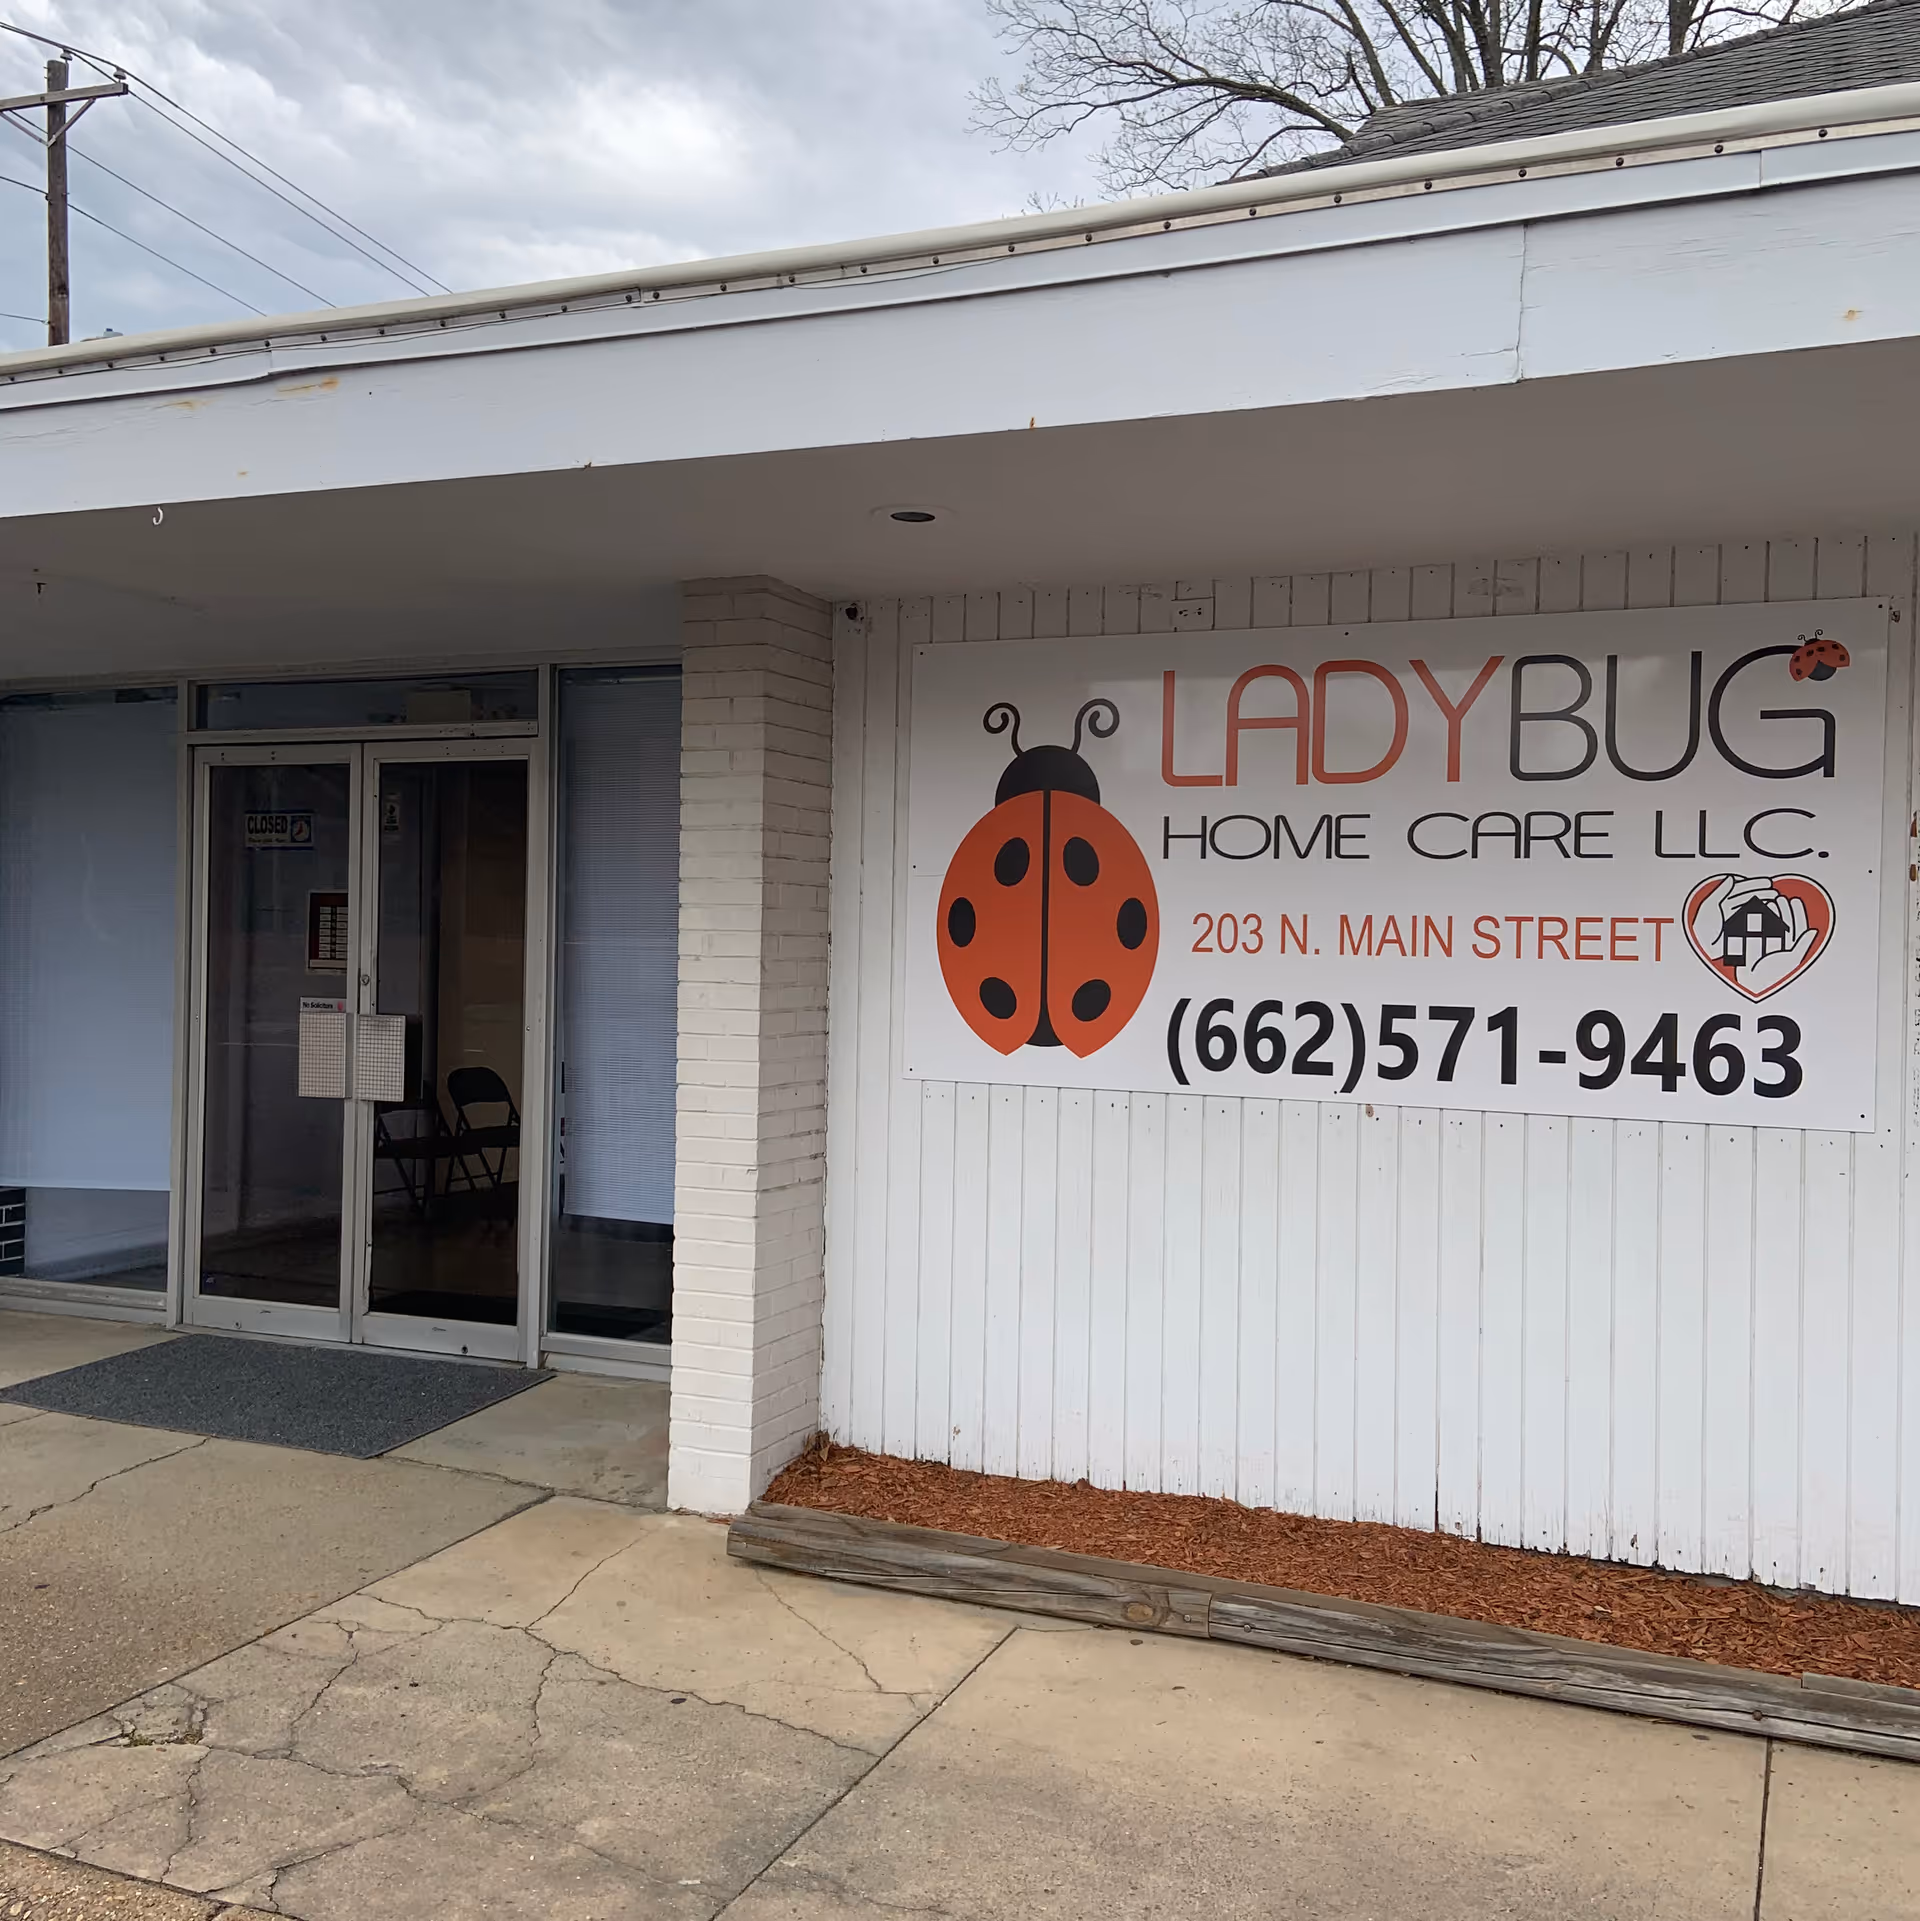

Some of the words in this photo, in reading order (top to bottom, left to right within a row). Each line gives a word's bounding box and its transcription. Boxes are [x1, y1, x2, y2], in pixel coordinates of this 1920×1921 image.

[1160, 645, 1837, 789] LADYBUG
[247, 815, 289, 835] CLOSED
[1162, 813, 1372, 861] HOME
[1406, 810, 1615, 860] CARE
[1654, 807, 1831, 860] LLC.
[1190, 912, 1265, 955] 203
[1279, 914, 1325, 956] N.
[1338, 914, 1454, 958] MAIN
[1471, 914, 1676, 963] STREET
[1166, 997, 1804, 1100] (662)571-9463
